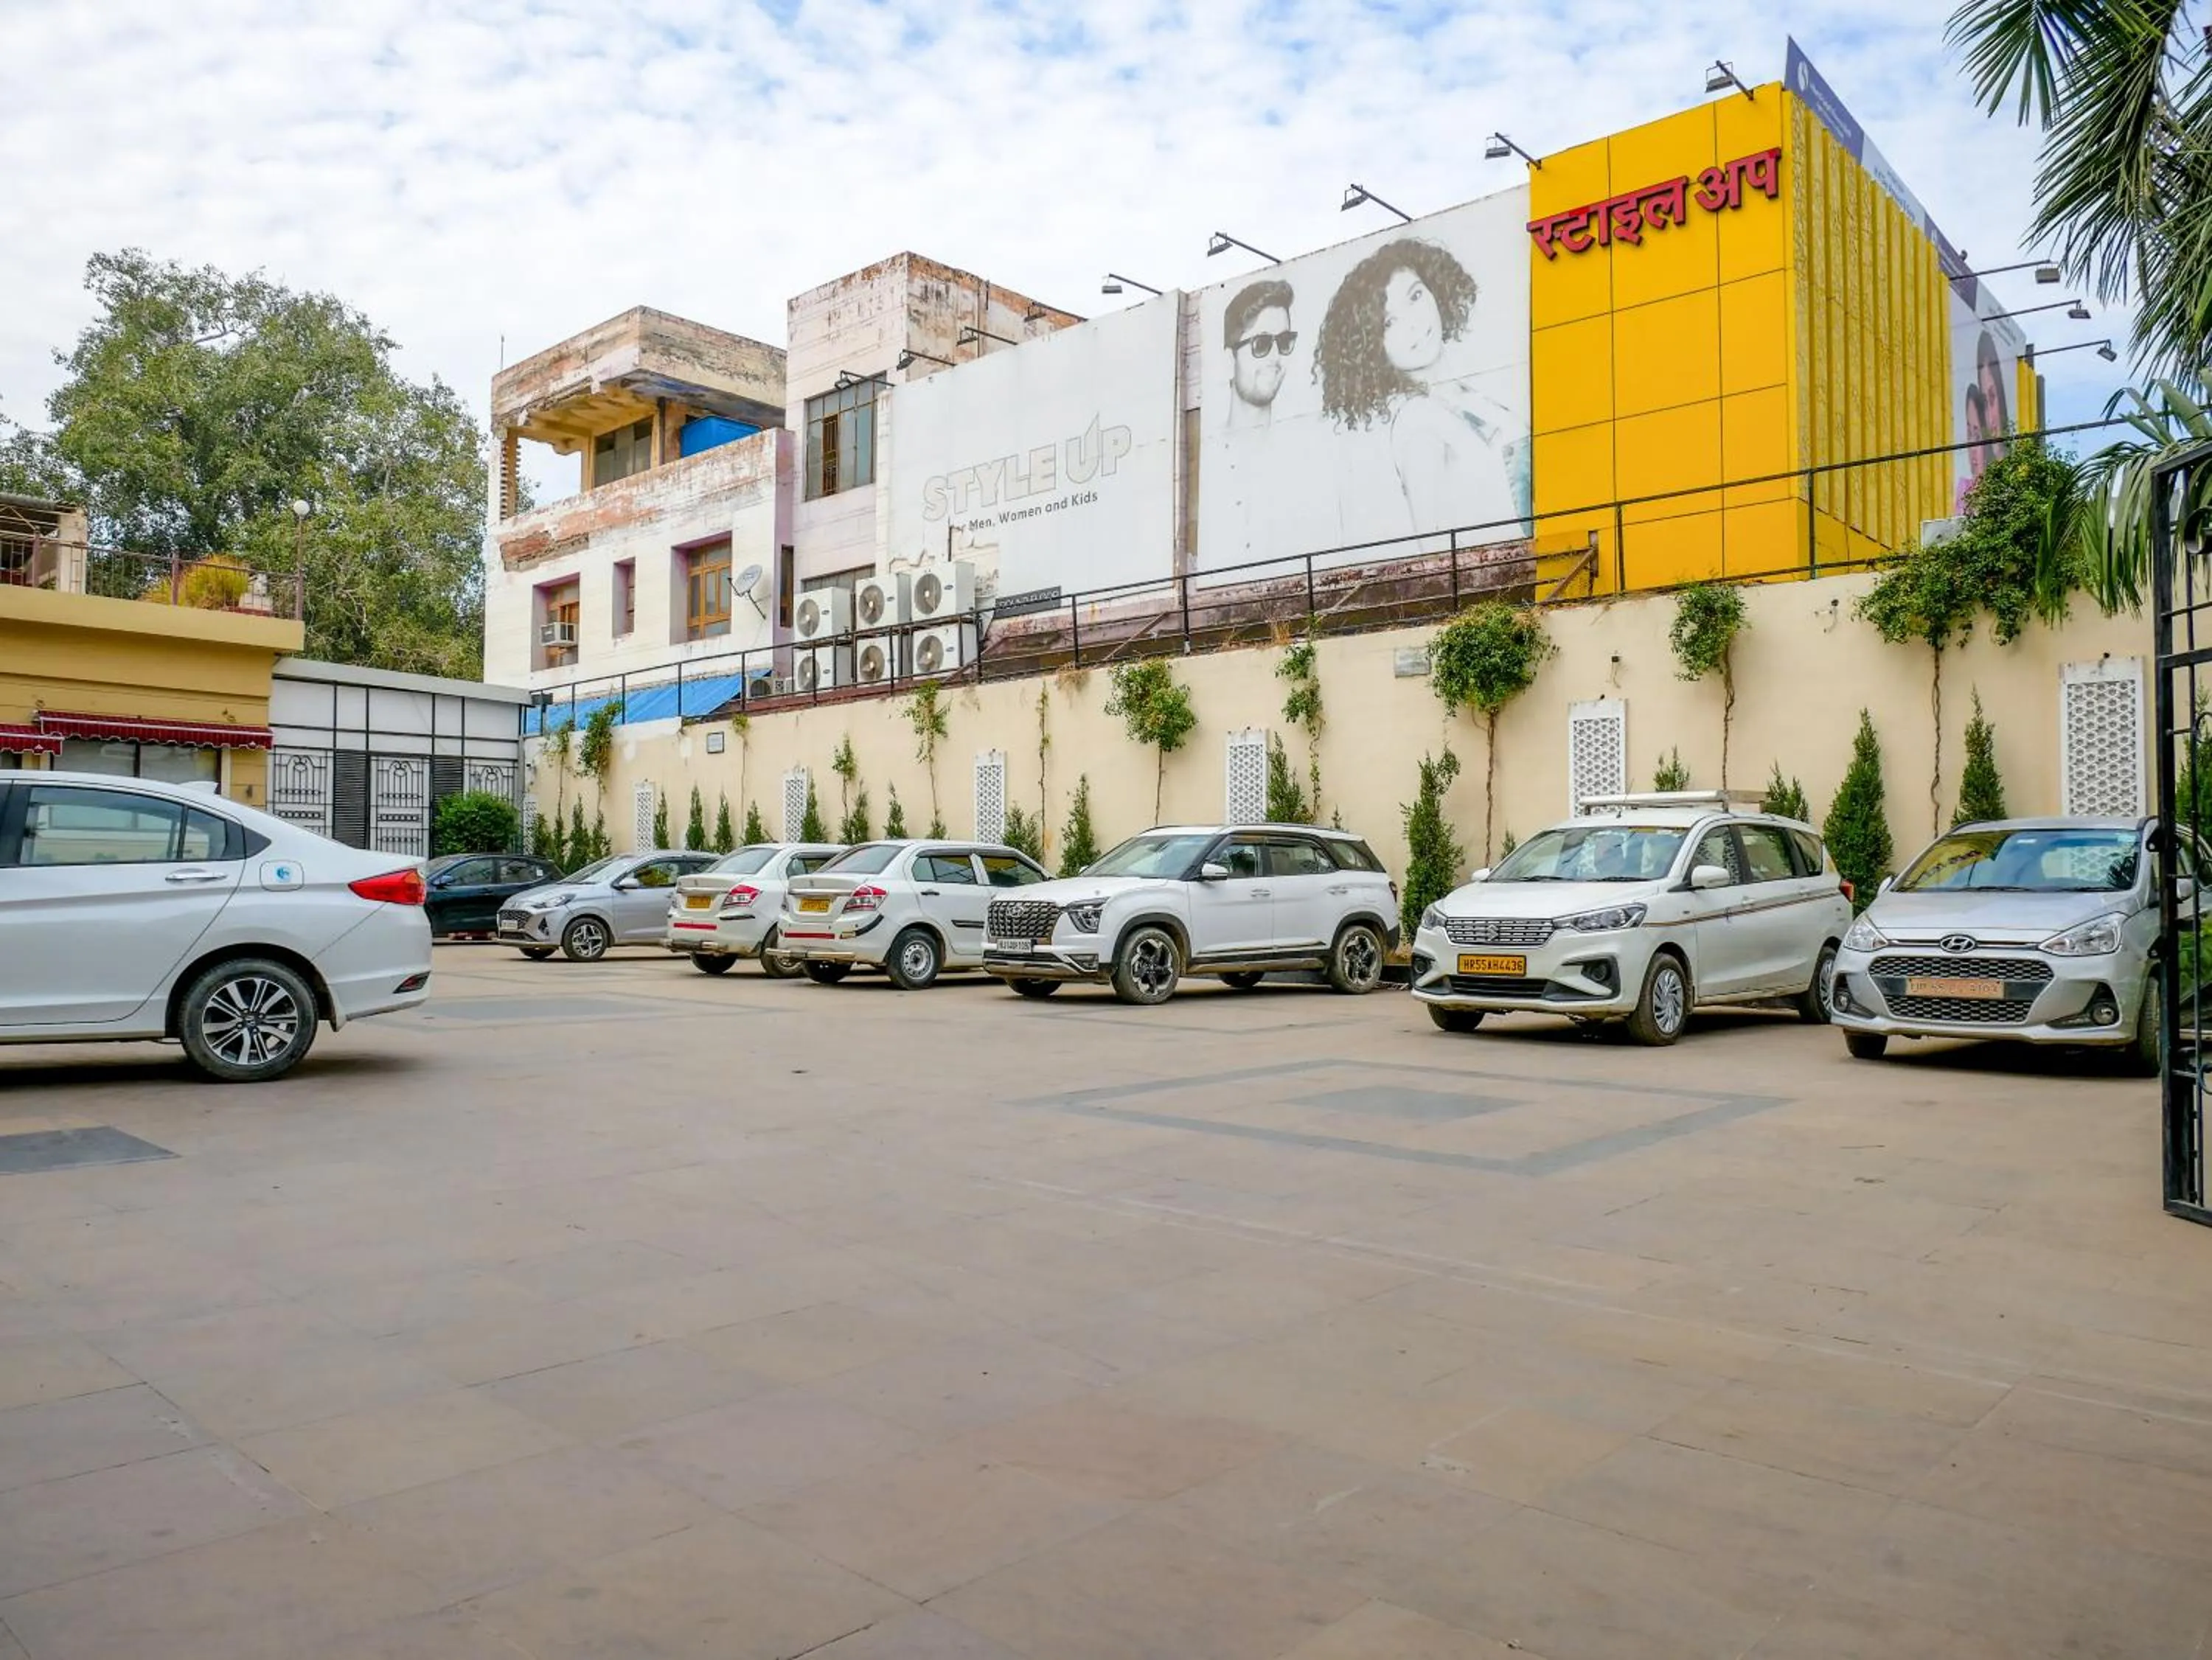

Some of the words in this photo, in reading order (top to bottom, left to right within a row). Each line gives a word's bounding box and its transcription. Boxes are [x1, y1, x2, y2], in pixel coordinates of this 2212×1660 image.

[1526, 175, 1688, 261] स्टाइल
[1694, 147, 1782, 212] अप
[922, 443, 1057, 521] STYLE
[1065, 411, 1132, 484] UP
[999, 505, 1042, 524] Women
[1045, 497, 1068, 512] and
[1071, 490, 1099, 506] Kids
[1464, 958, 1523, 972] HR55AH4436
